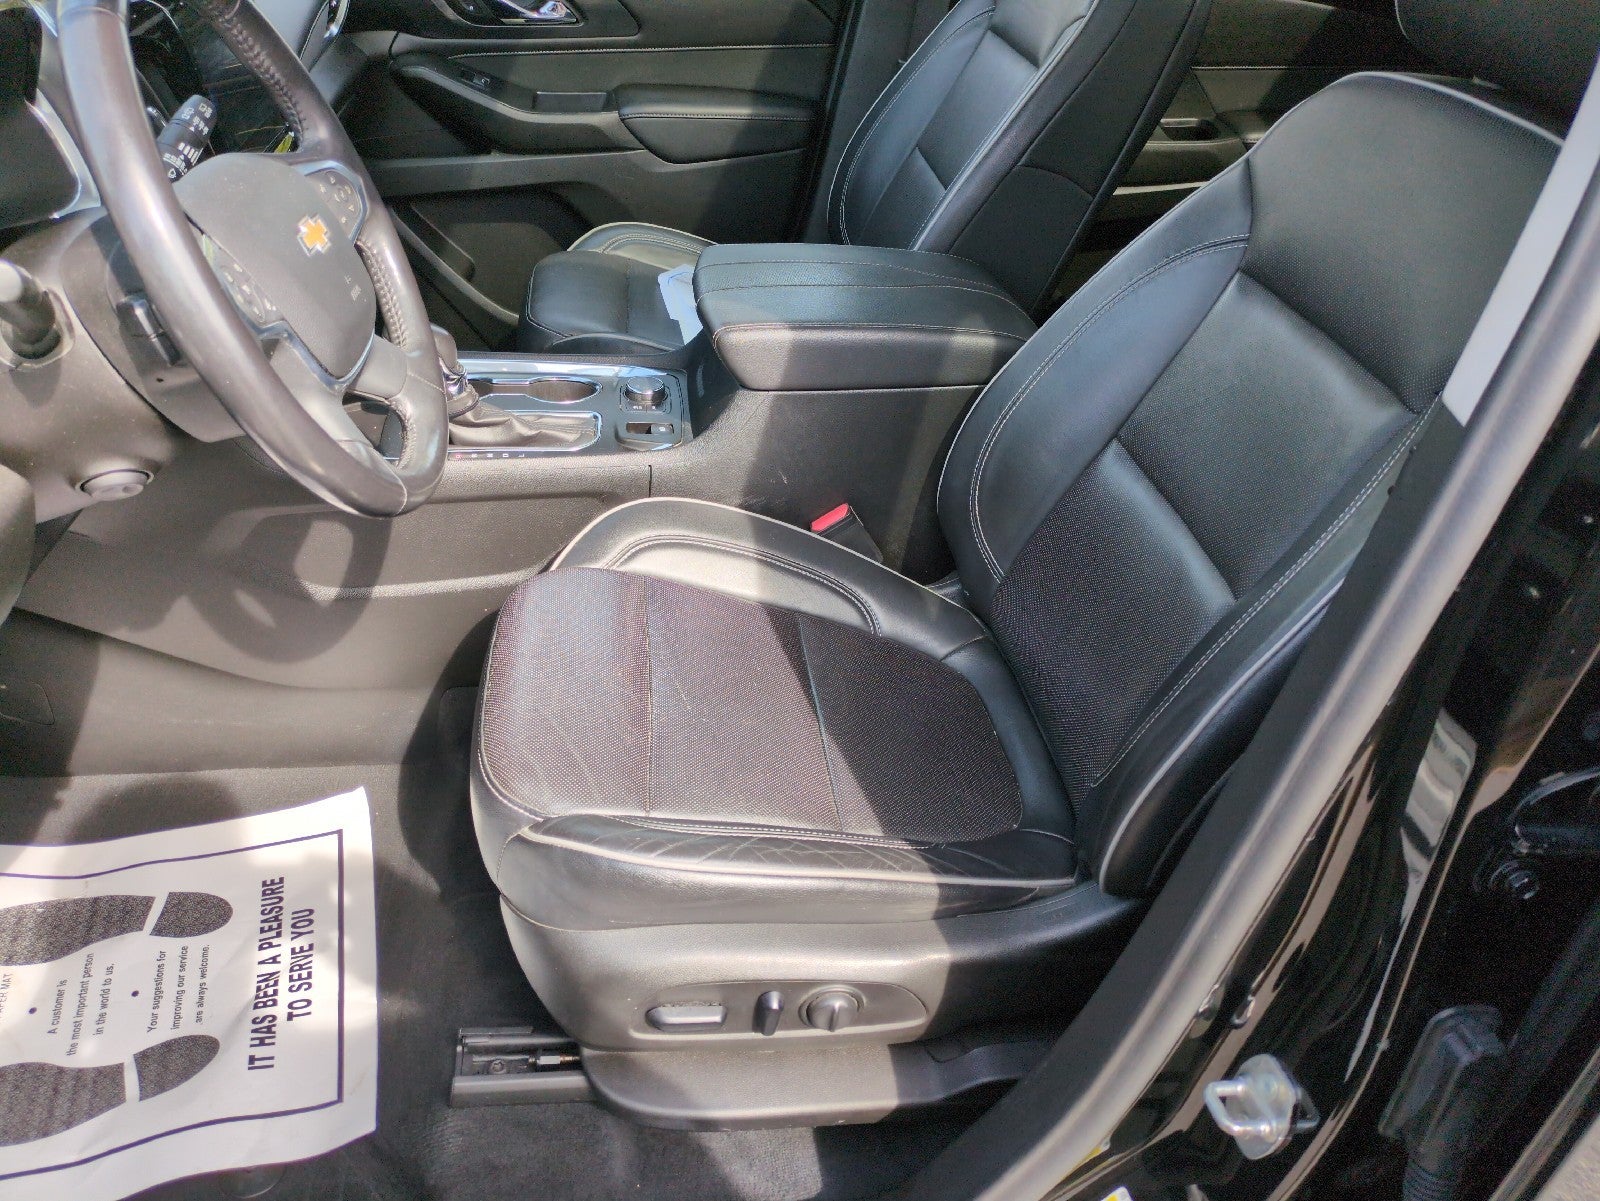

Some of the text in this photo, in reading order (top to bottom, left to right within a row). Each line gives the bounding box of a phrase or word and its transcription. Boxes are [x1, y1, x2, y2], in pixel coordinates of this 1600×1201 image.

[248, 877, 285, 1070] IT HAS BEEN A PLEASURE
[287, 908, 315, 1022] TO SERVE YOU
[1, 973, 13, 990] MAT
[57, 979, 68, 988] is
[102, 977, 112, 987] to
[147, 951, 167, 1033] Your suggestions for
[170, 989, 186, 1030] improving
[179, 945, 189, 973] service
[51, 988, 66, 1026] customer
[66, 953, 94, 1056] the most important person
[100, 988, 111, 1010] world
[196, 981, 209, 1009] always
[95, 1012, 107, 1025] the
[195, 1010, 204, 1024] are
[92, 1027, 104, 1036] in
